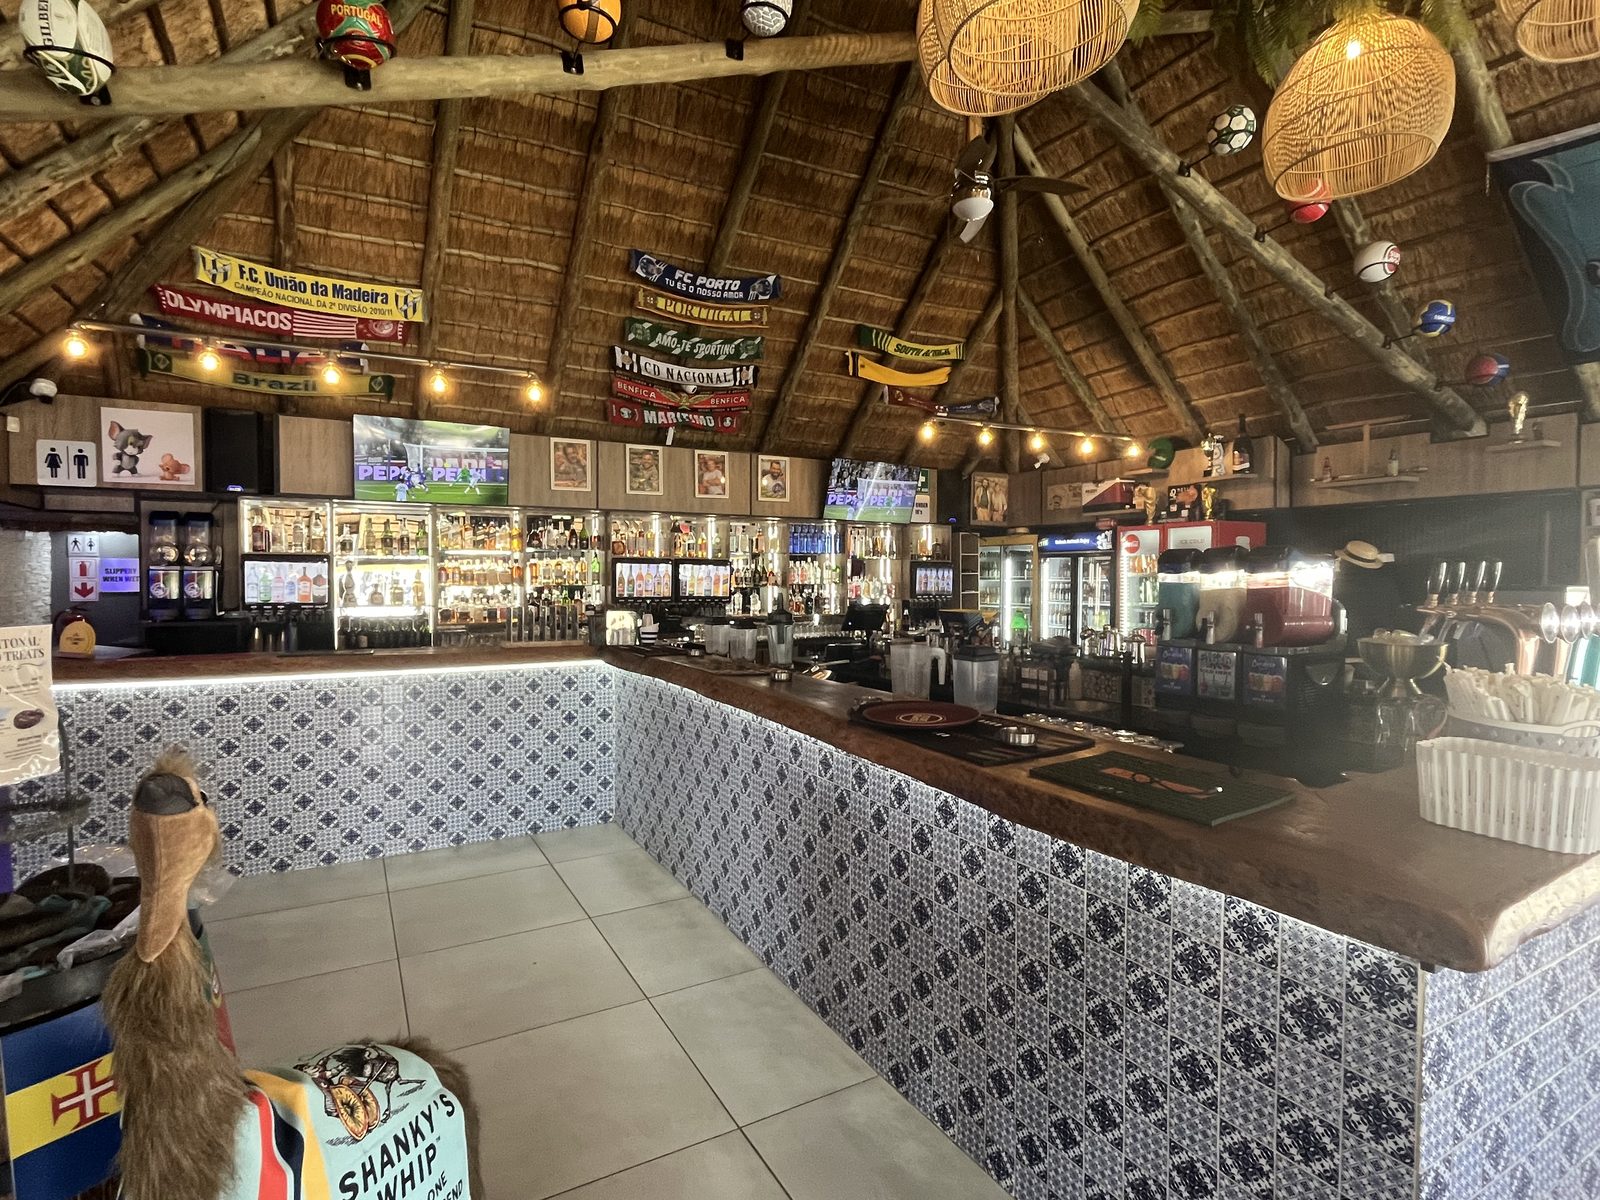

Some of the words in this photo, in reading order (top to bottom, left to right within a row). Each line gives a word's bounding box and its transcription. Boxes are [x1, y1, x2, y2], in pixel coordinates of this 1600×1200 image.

[37, 0, 54, 46] GILBE
[331, 4, 382, 28] PORTUGAL
[238, 264, 262, 286] F.C.
[265, 272, 307, 294] União
[310, 281, 328, 297] da
[331, 284, 389, 306] Madeira
[665, 278, 675, 287] TU
[688, 285, 695, 293] O
[723, 291, 744, 299] AMOR
[674, 269, 694, 284] FC
[696, 276, 741, 290] PORTO
[163, 290, 293, 331] OLYMPIACOS
[234, 281, 274, 299] CAMPEÃO
[275, 292, 314, 307] NACIONAL
[316, 300, 328, 309] DA
[338, 303, 368, 314] DIVISÃO
[369, 307, 393, 317] 2010/11
[655, 333, 692, 352] AMO-TE
[693, 343, 735, 356] SPORTING
[894, 343, 923, 357] SOUTH
[232, 370, 317, 393] Brazil
[644, 361, 660, 377] CD
[666, 367, 731, 384] NACIONAL
[617, 381, 656, 399] BENFICA
[710, 396, 746, 405] BENFICA
[0, 636, 40, 649] TONAL
[339, 1094, 455, 1200] SHANKY'S
[442, 1179, 463, 1200] END
